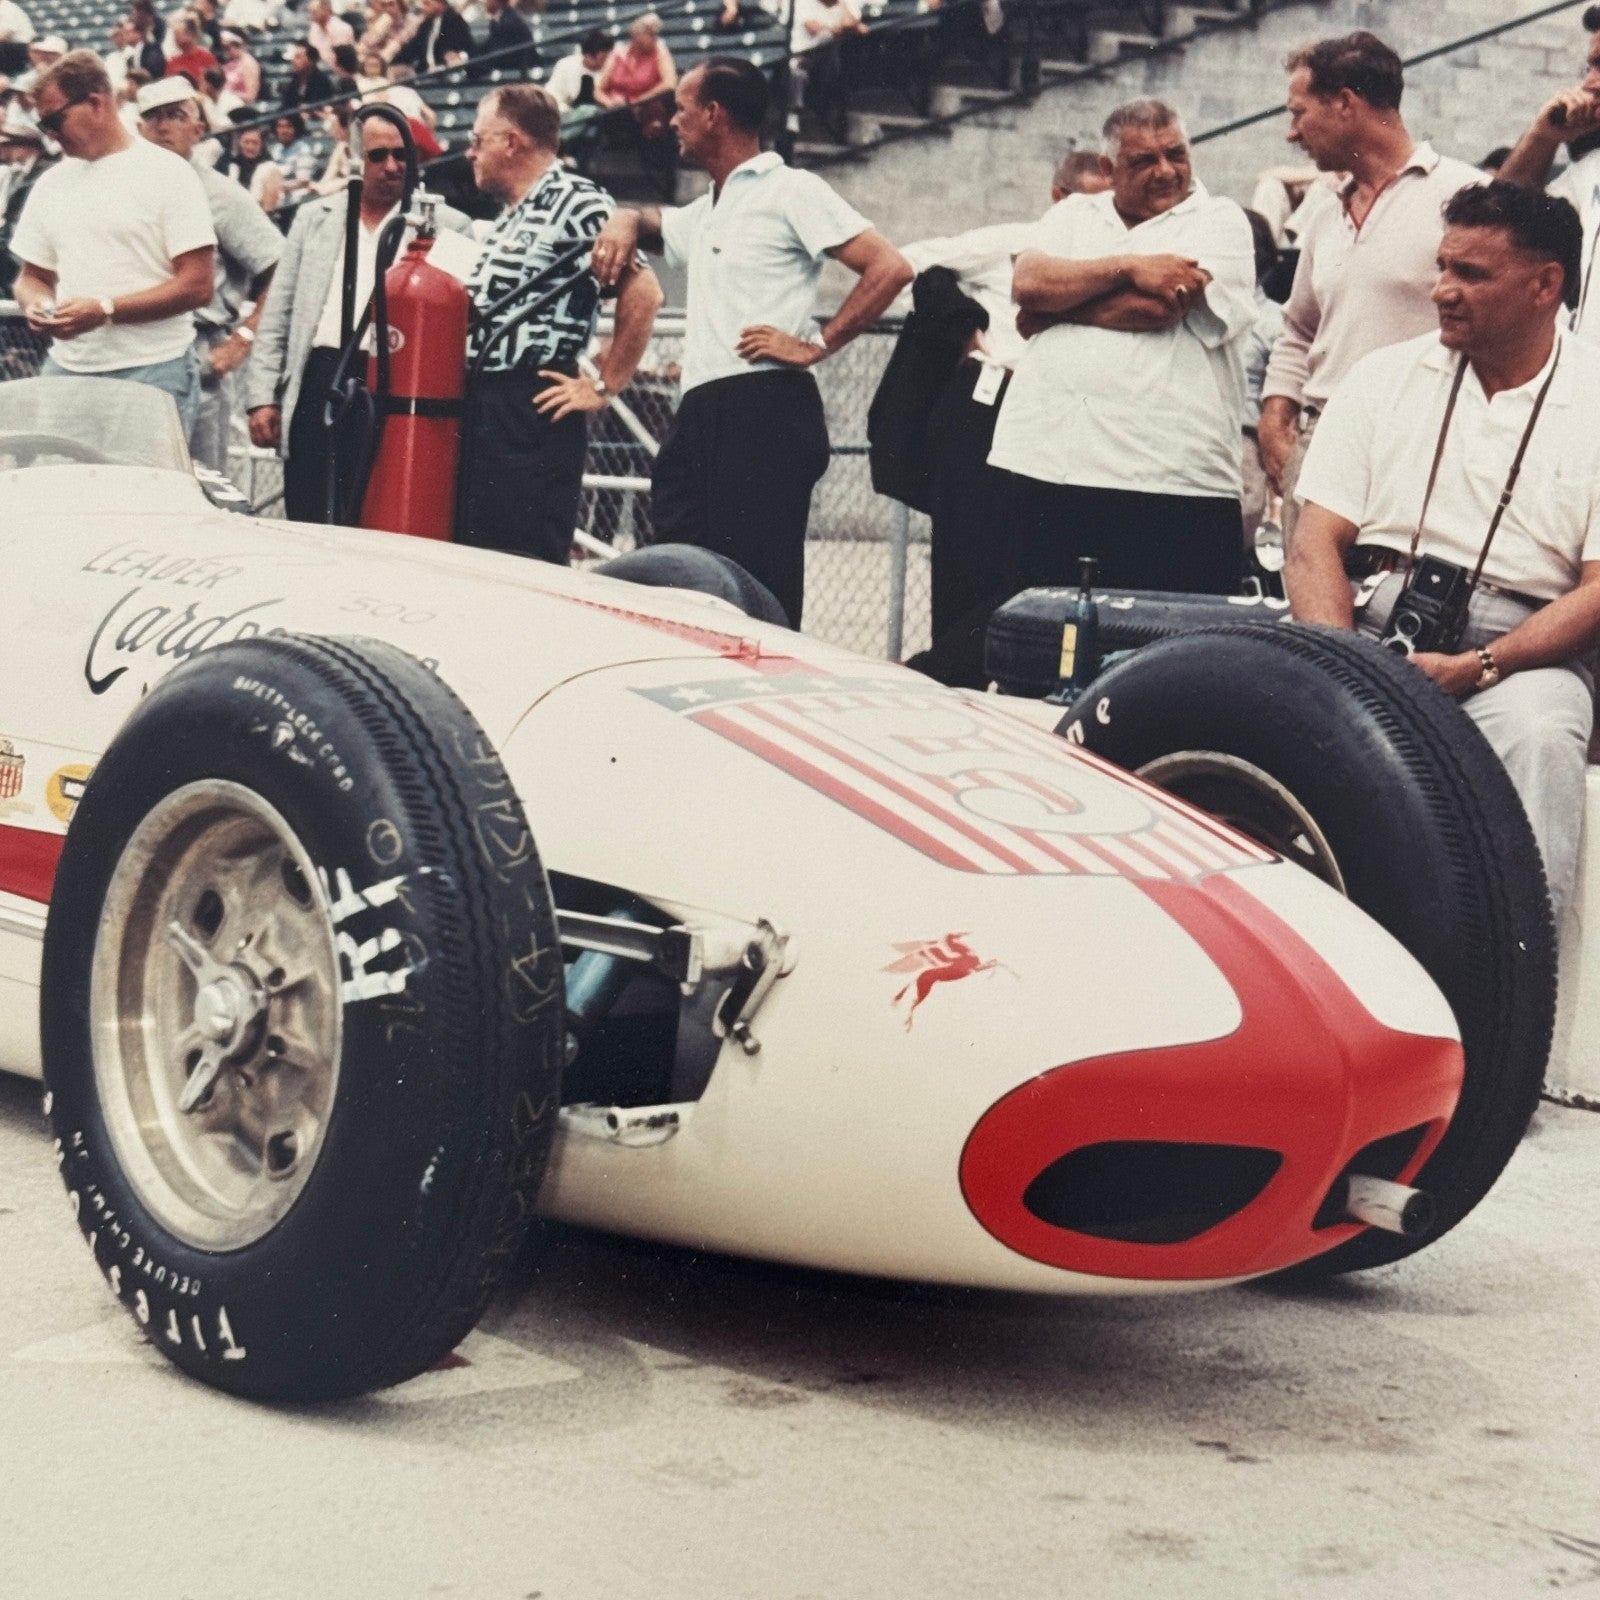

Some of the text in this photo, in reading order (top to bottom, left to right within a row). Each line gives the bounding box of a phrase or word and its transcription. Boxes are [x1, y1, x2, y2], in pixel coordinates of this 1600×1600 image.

[81, 540, 243, 589] LEADER
[338, 594, 439, 625] 500
[72, 1130, 202, 1297] DELUXE CHAMPON
